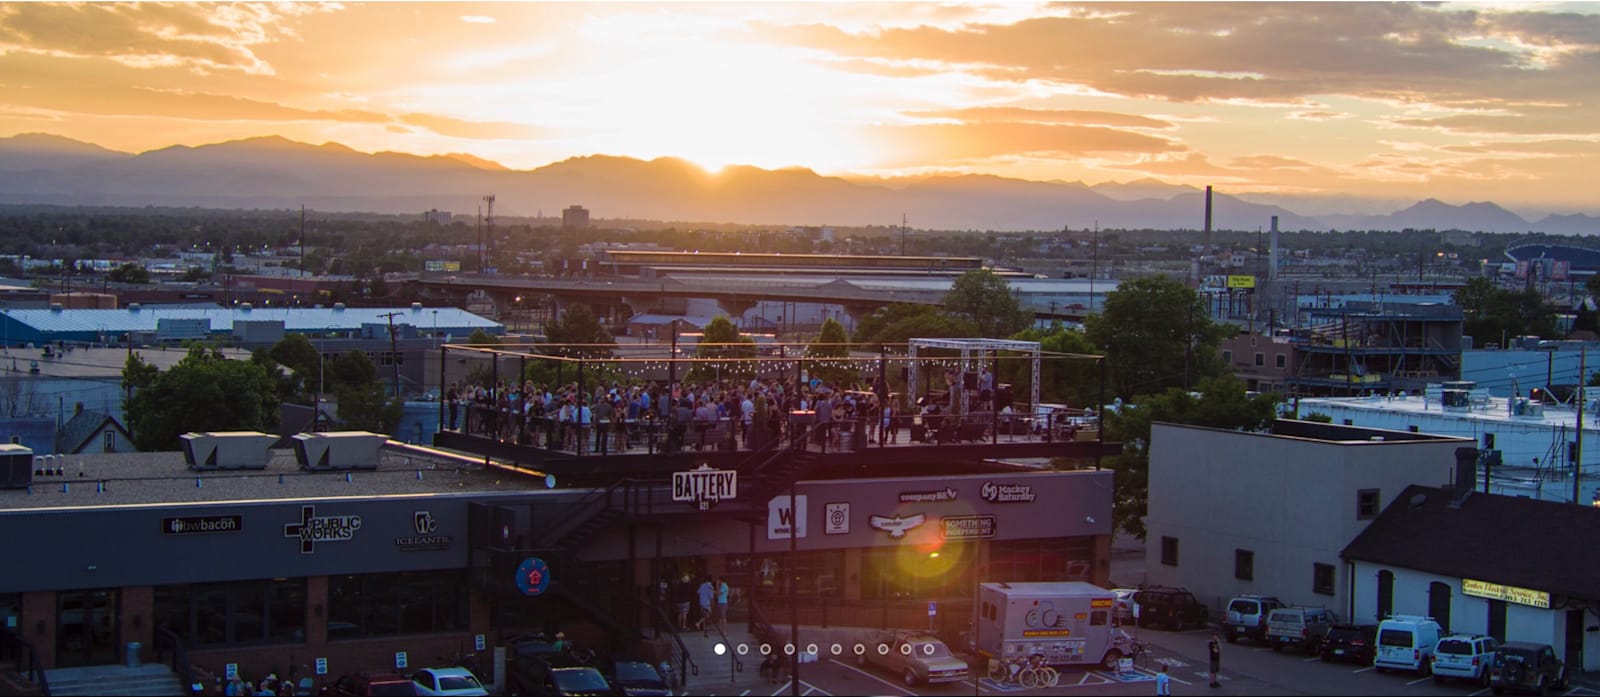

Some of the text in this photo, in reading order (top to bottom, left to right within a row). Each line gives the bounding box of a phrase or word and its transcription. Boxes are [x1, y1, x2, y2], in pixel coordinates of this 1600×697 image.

[675, 473, 735, 499] BATTERY
[998, 493, 1036, 502] Saturday
[312, 517, 361, 529] PUBLIC
[946, 518, 993, 529] SOMETHNG
[301, 527, 352, 540] WORKS
[946, 528, 993, 537] INDEPENDNT
